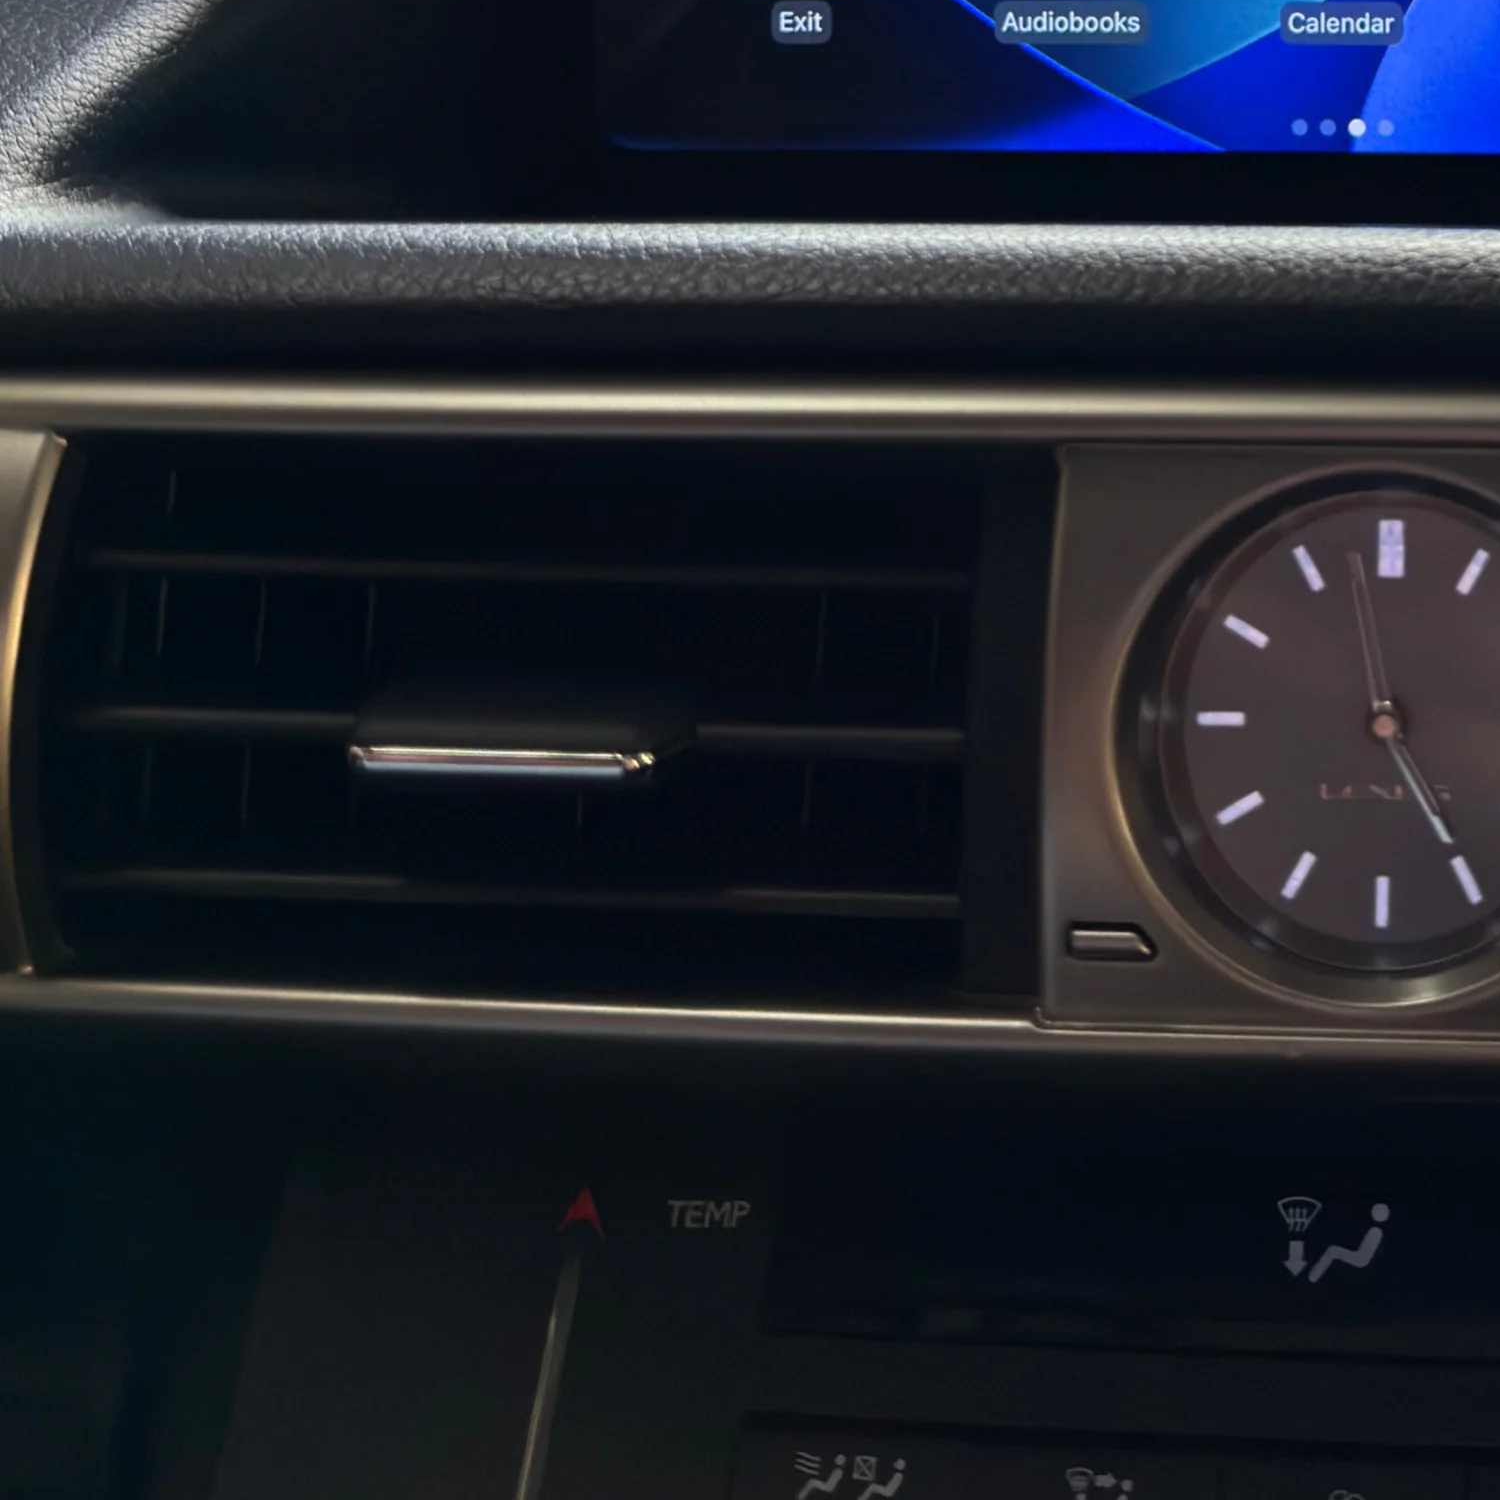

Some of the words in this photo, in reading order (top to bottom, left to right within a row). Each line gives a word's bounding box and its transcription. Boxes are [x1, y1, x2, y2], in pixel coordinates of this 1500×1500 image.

[778, 11, 823, 35] Exit
[1001, 11, 1141, 35] Audiobooks
[1287, 11, 1394, 36] Calendar
[667, 1199, 751, 1230] TEMP
